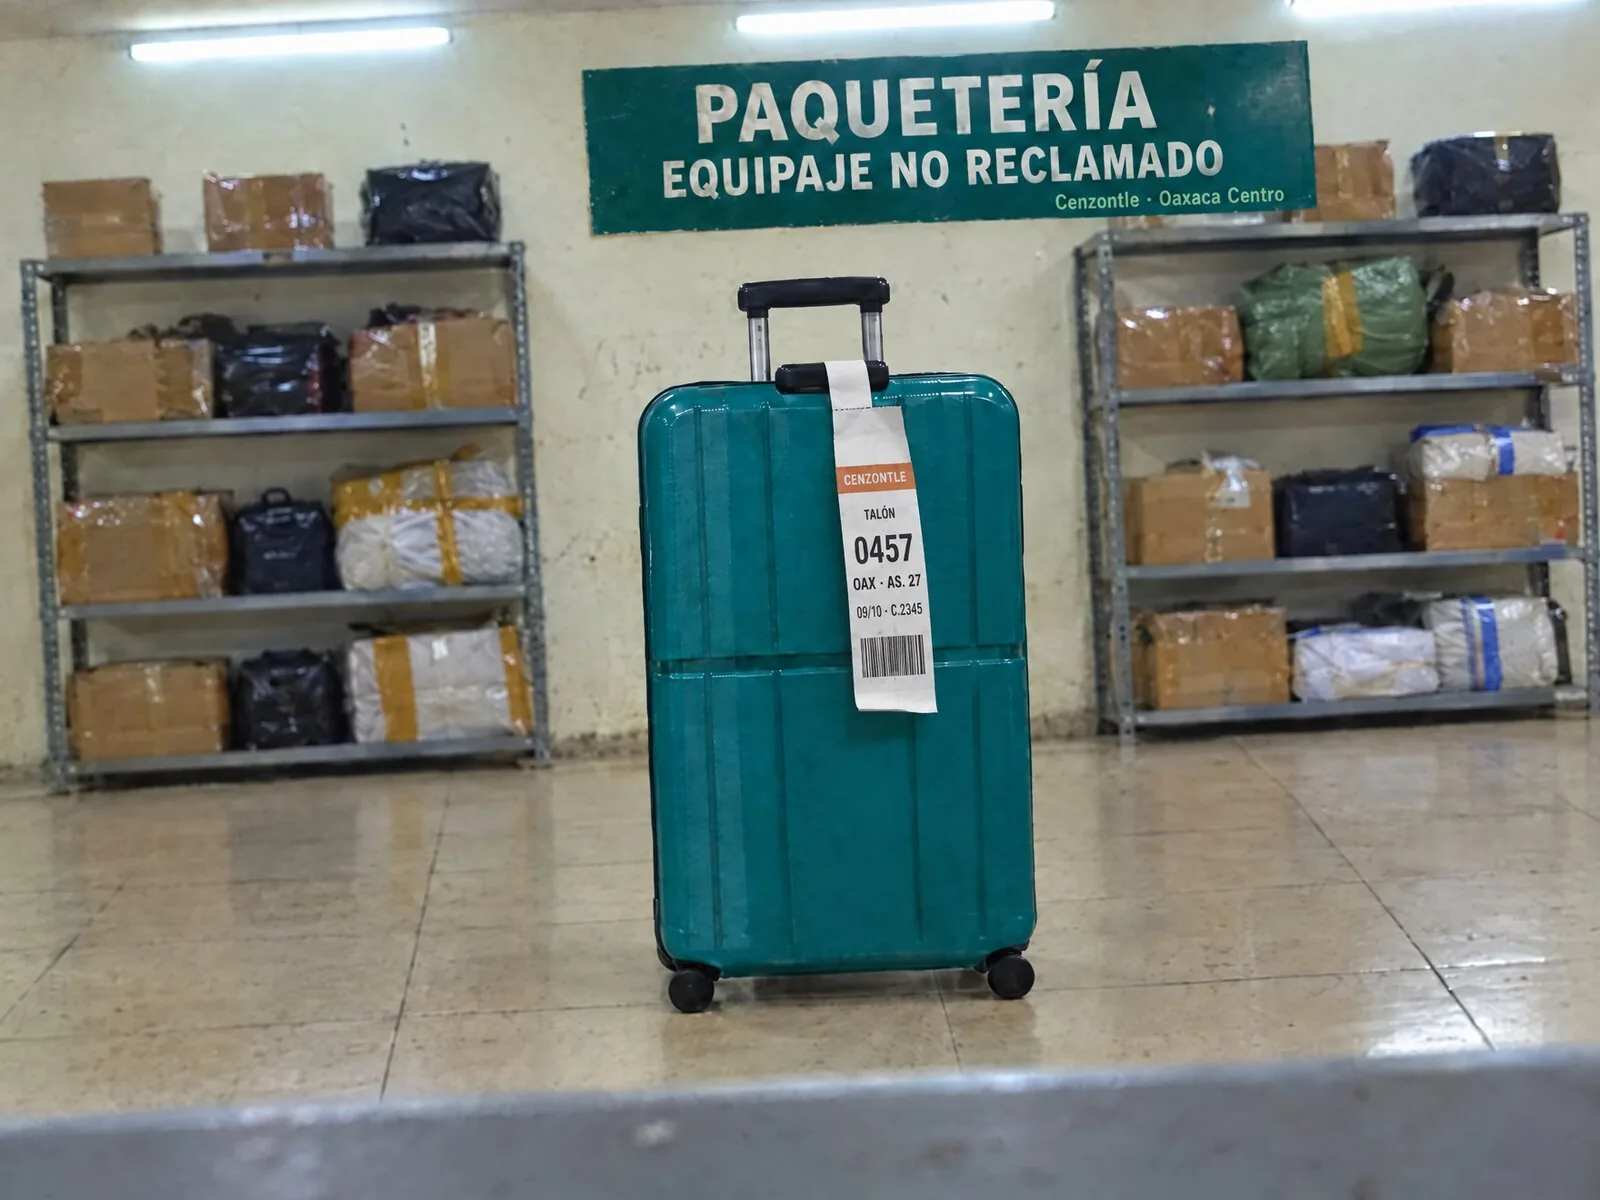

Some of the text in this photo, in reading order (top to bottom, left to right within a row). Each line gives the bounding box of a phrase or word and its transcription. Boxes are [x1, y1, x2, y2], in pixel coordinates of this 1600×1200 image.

[695, 58, 1157, 145] PAQUETERÍA
[662, 139, 1224, 199] EQUIPAJE NO RECLAMADO
[1055, 191, 1140, 210] Cenzontle
[1159, 189, 1221, 207] Oaxaca
[1227, 187, 1285, 204] Centro
[843, 471, 907, 486] CENZONTLE
[864, 506, 896, 521] TALÓN
[854, 532, 913, 565] 0457
[852, 576, 877, 591] OAX
[887, 575, 906, 589] AS.
[907, 573, 921, 588] 27
[856, 604, 882, 620] 09/10
[890, 602, 923, 617] C.2345
